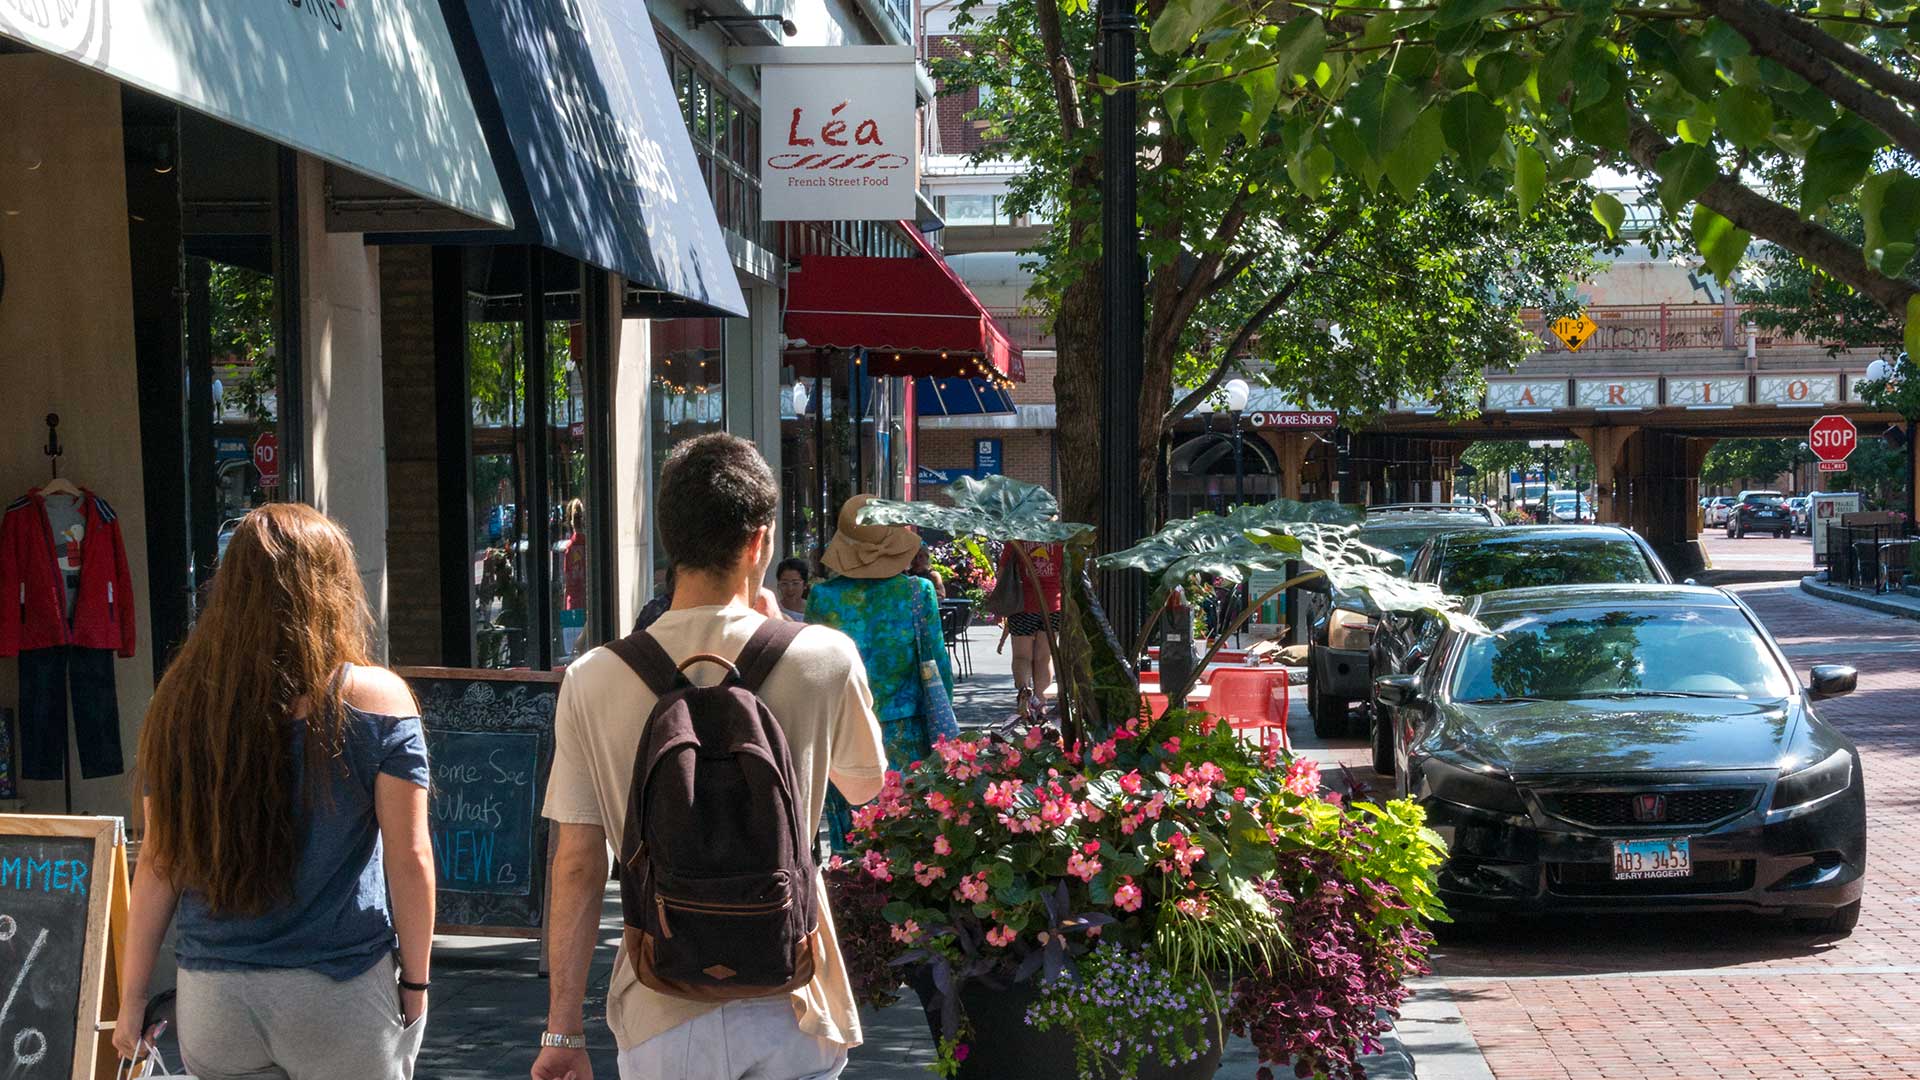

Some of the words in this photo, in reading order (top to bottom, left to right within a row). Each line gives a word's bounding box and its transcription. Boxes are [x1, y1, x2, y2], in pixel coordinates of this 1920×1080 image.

[788, 101, 883, 146] Léa
[788, 177, 826, 187] French
[828, 177, 860, 187] Street
[863, 176, 889, 187] Food
[1813, 430, 1853, 447] STOP
[436, 756, 482, 783] ome
[436, 788, 503, 828] What's
[433, 830, 494, 882] NEW
[1652, 850, 1687, 870] 3453
[1615, 871, 1643, 880] JERRY
[1644, 870, 1690, 879] HAGGERTY
